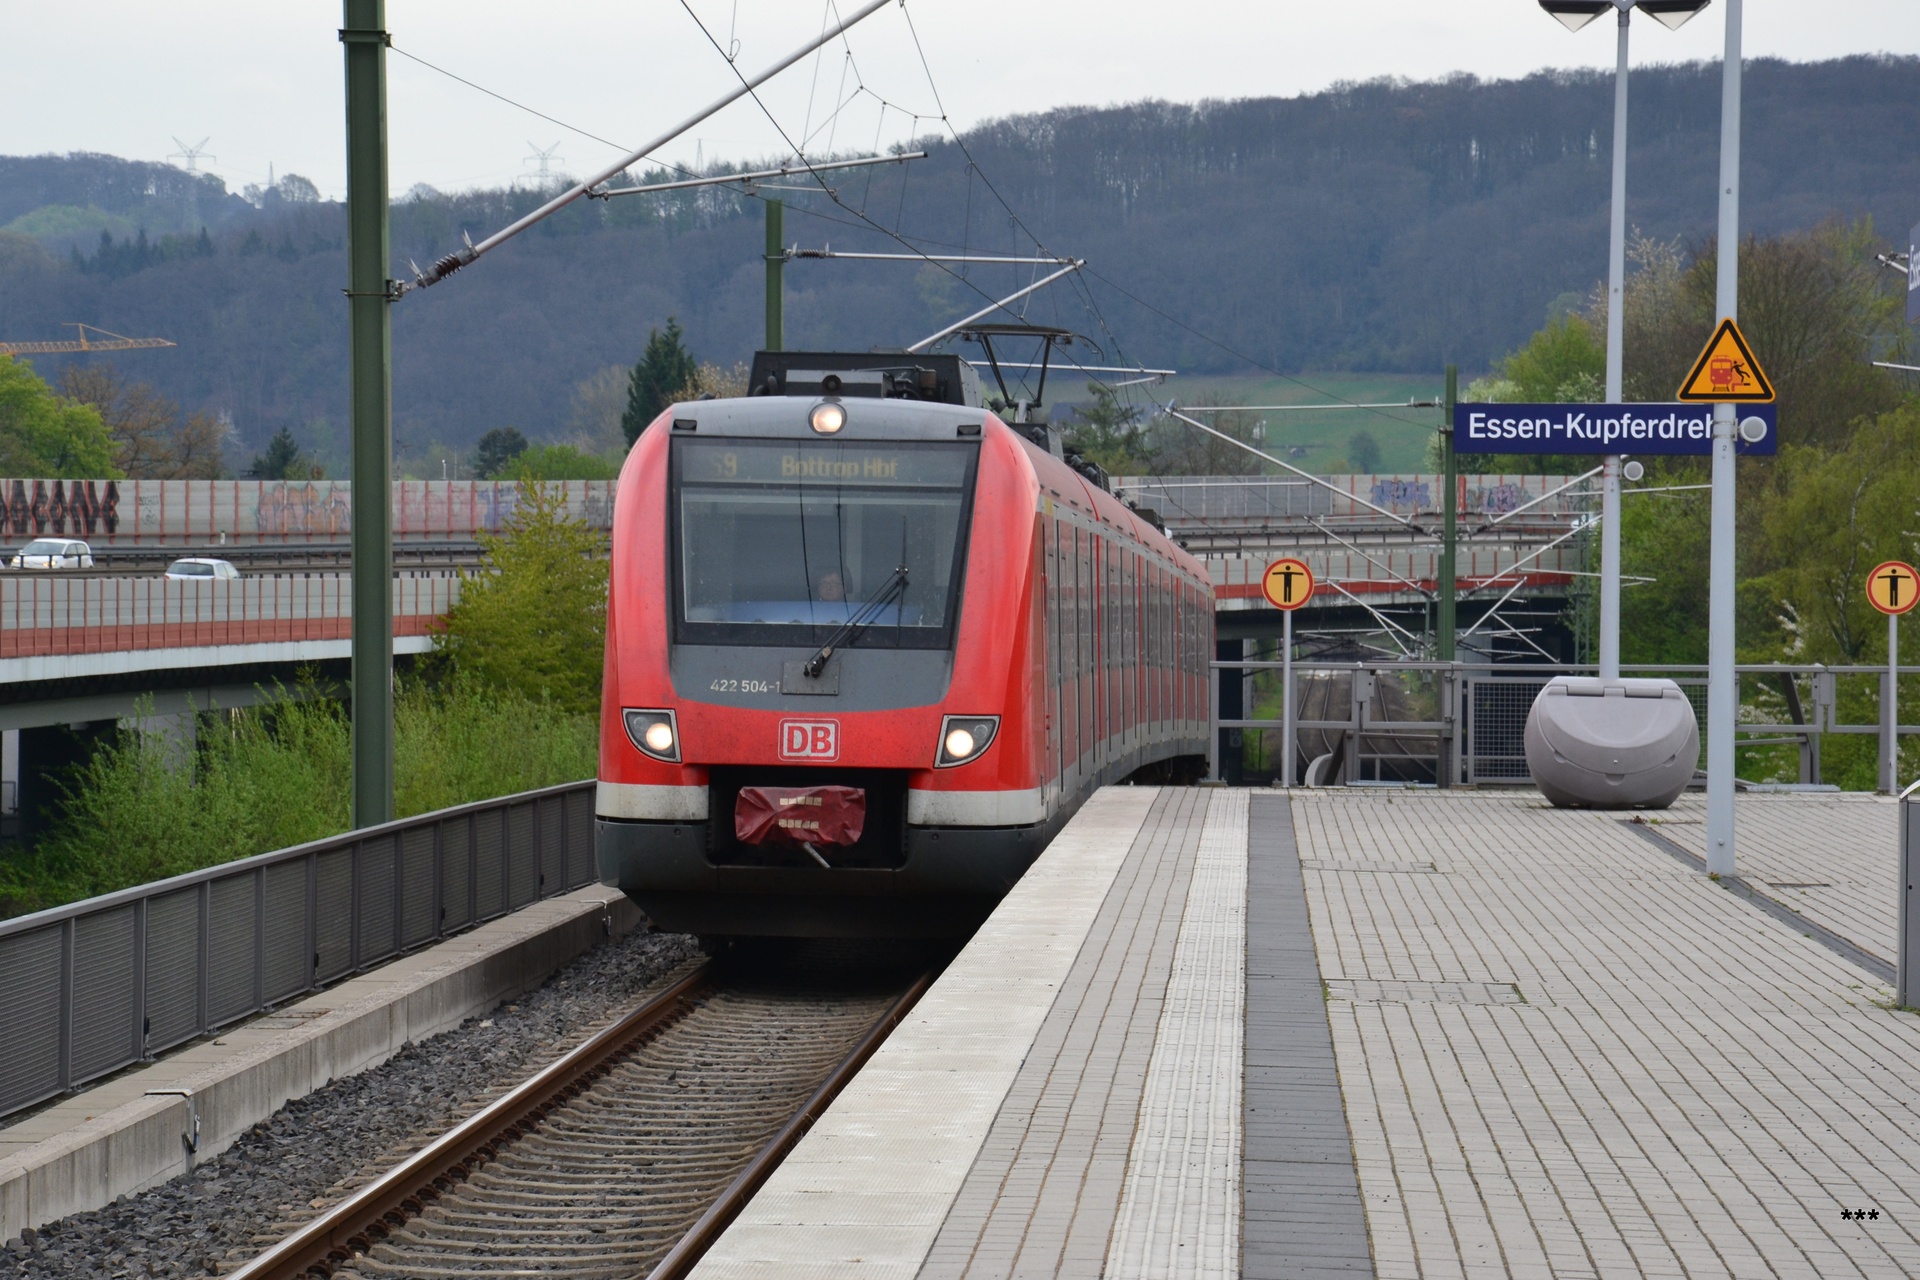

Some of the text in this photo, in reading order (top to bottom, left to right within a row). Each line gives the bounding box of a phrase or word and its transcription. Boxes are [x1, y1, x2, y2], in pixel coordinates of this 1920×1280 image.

[781, 455, 859, 477] Bottrop
[863, 457, 898, 478] Hbf
[710, 680, 780, 693] 422 504-1
[786, 725, 832, 754] DB
